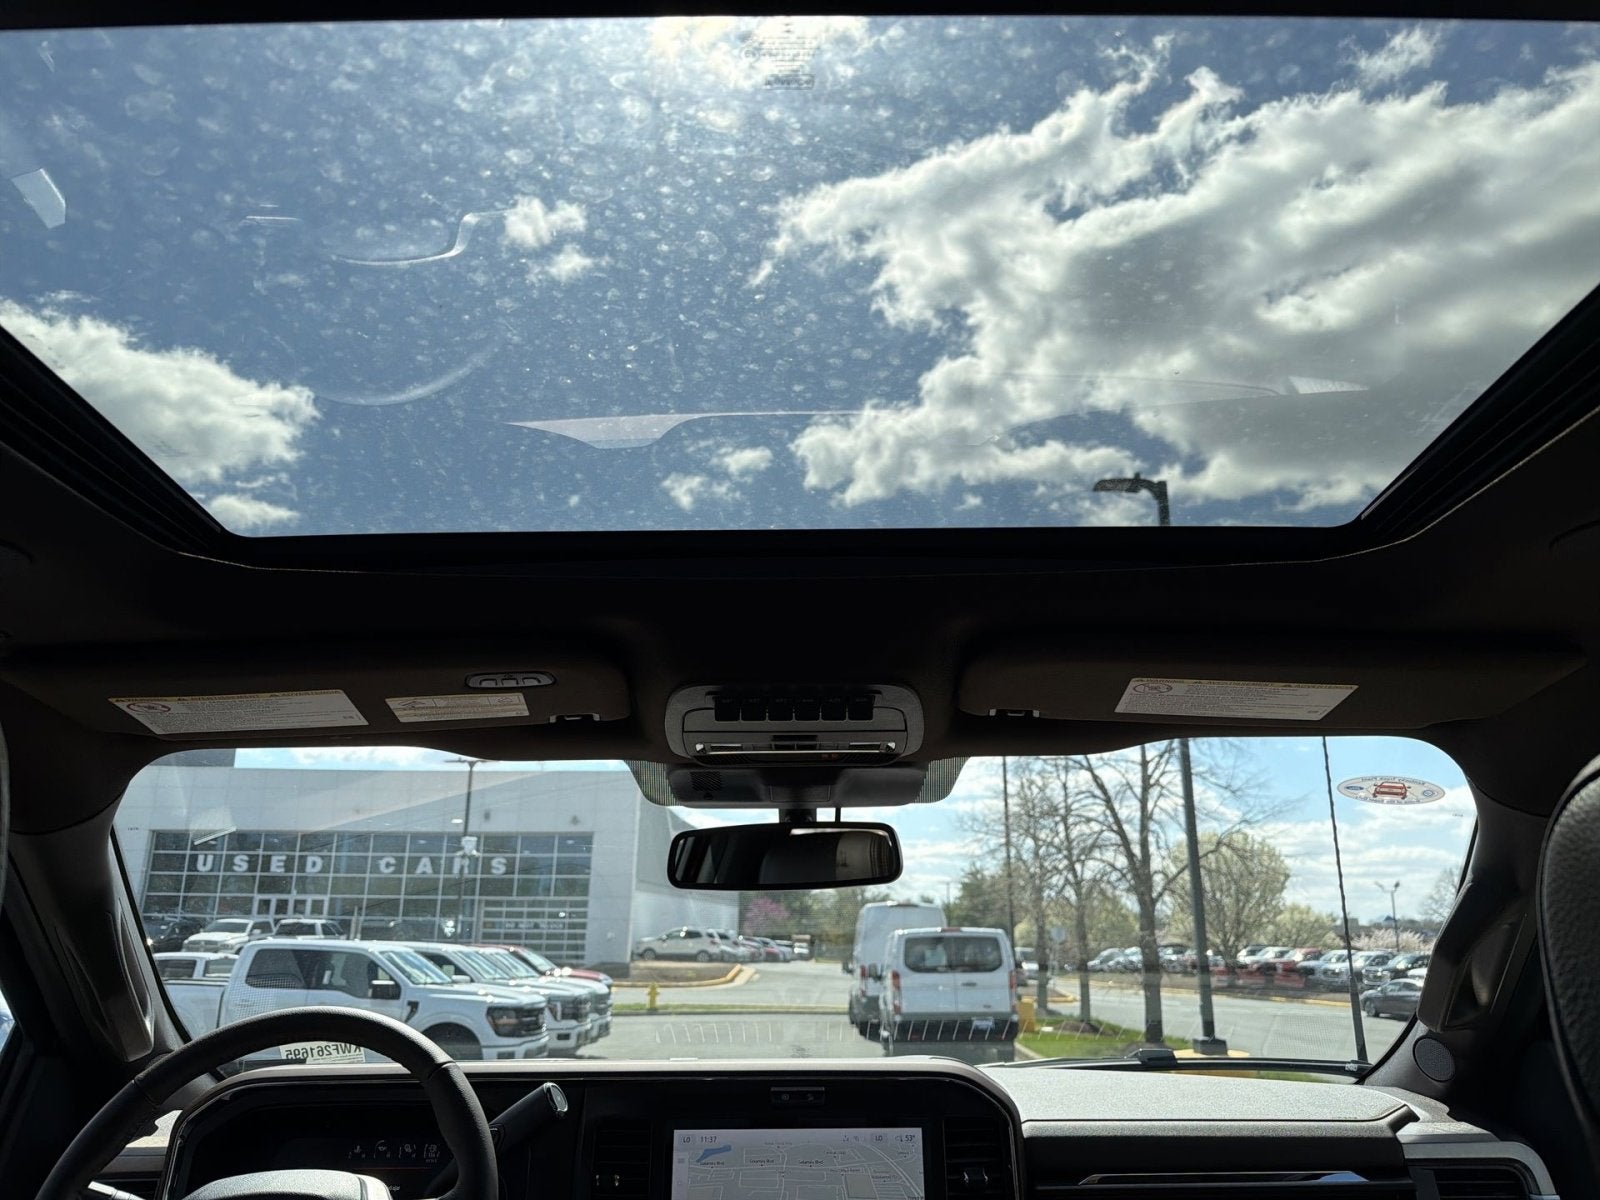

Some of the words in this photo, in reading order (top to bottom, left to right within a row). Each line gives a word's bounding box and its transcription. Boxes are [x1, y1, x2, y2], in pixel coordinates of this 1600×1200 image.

[196, 854, 323, 873] USED
[377, 856, 508, 874] CARS
[700, 1135, 717, 1143] 11:37
